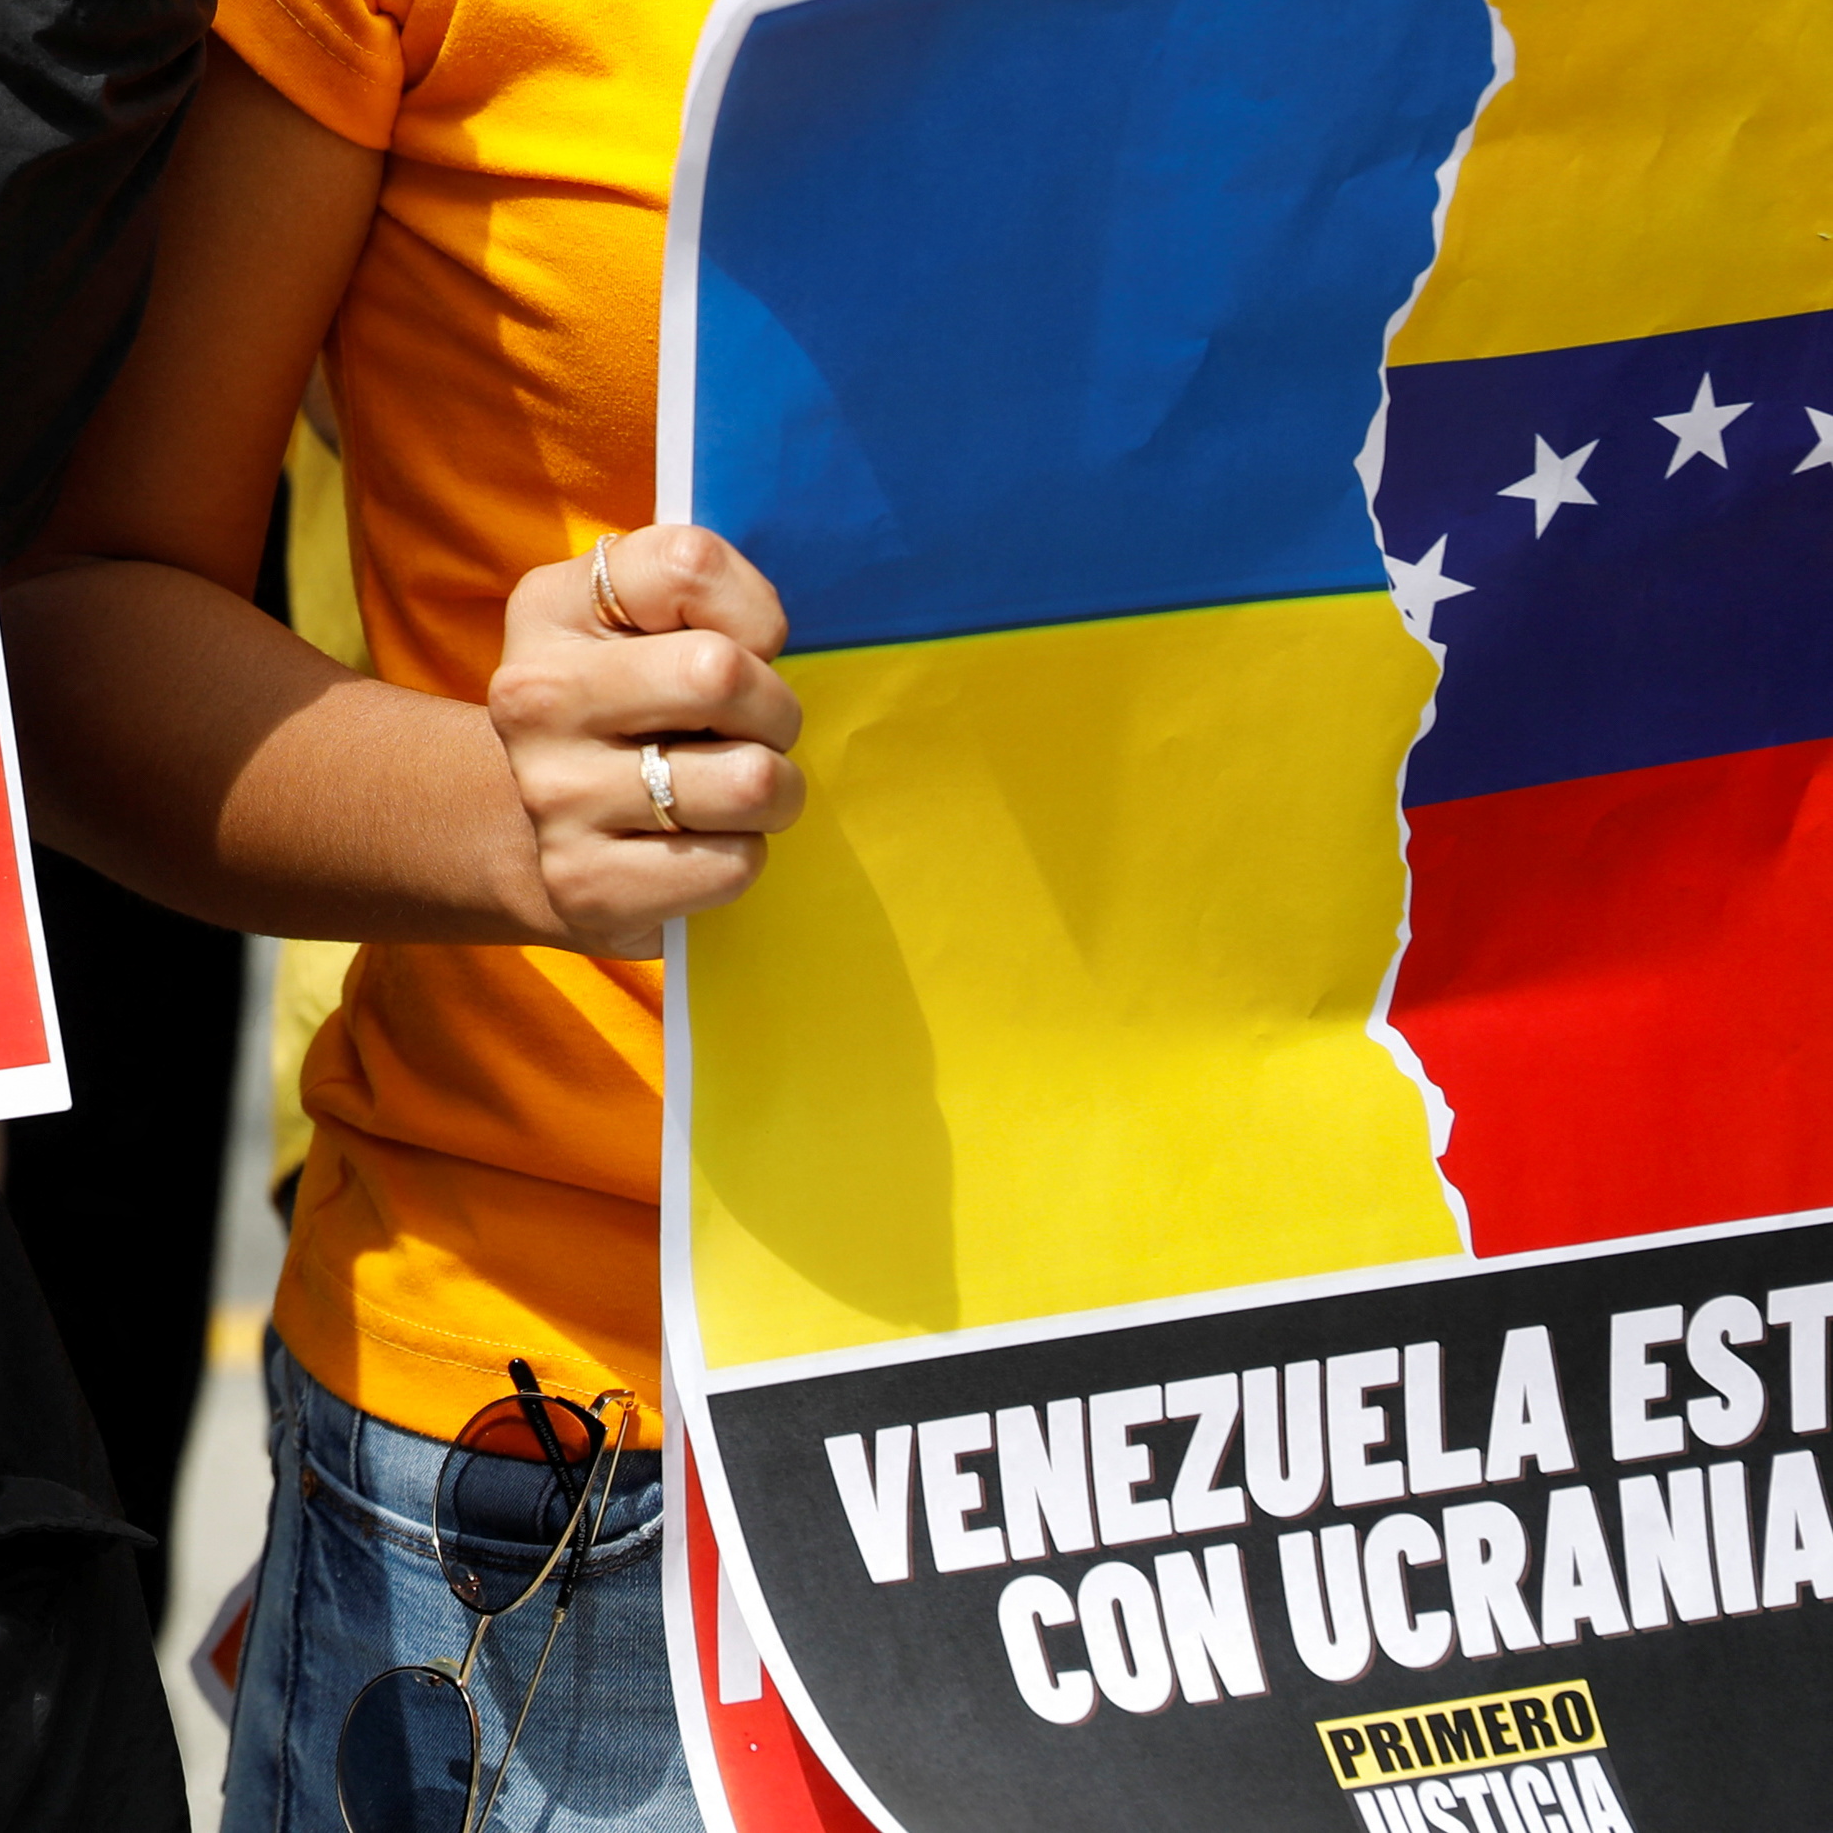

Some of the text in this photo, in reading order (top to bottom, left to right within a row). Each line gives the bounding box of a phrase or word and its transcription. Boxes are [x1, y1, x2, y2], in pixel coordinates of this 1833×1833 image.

[824, 1281, 1833, 1585] VENEZUELA EST
[997, 1543, 1271, 1725] CON
[1277, 1450, 1833, 1684] UCRANIA
[1326, 1689, 1596, 1780] PRIMERO
